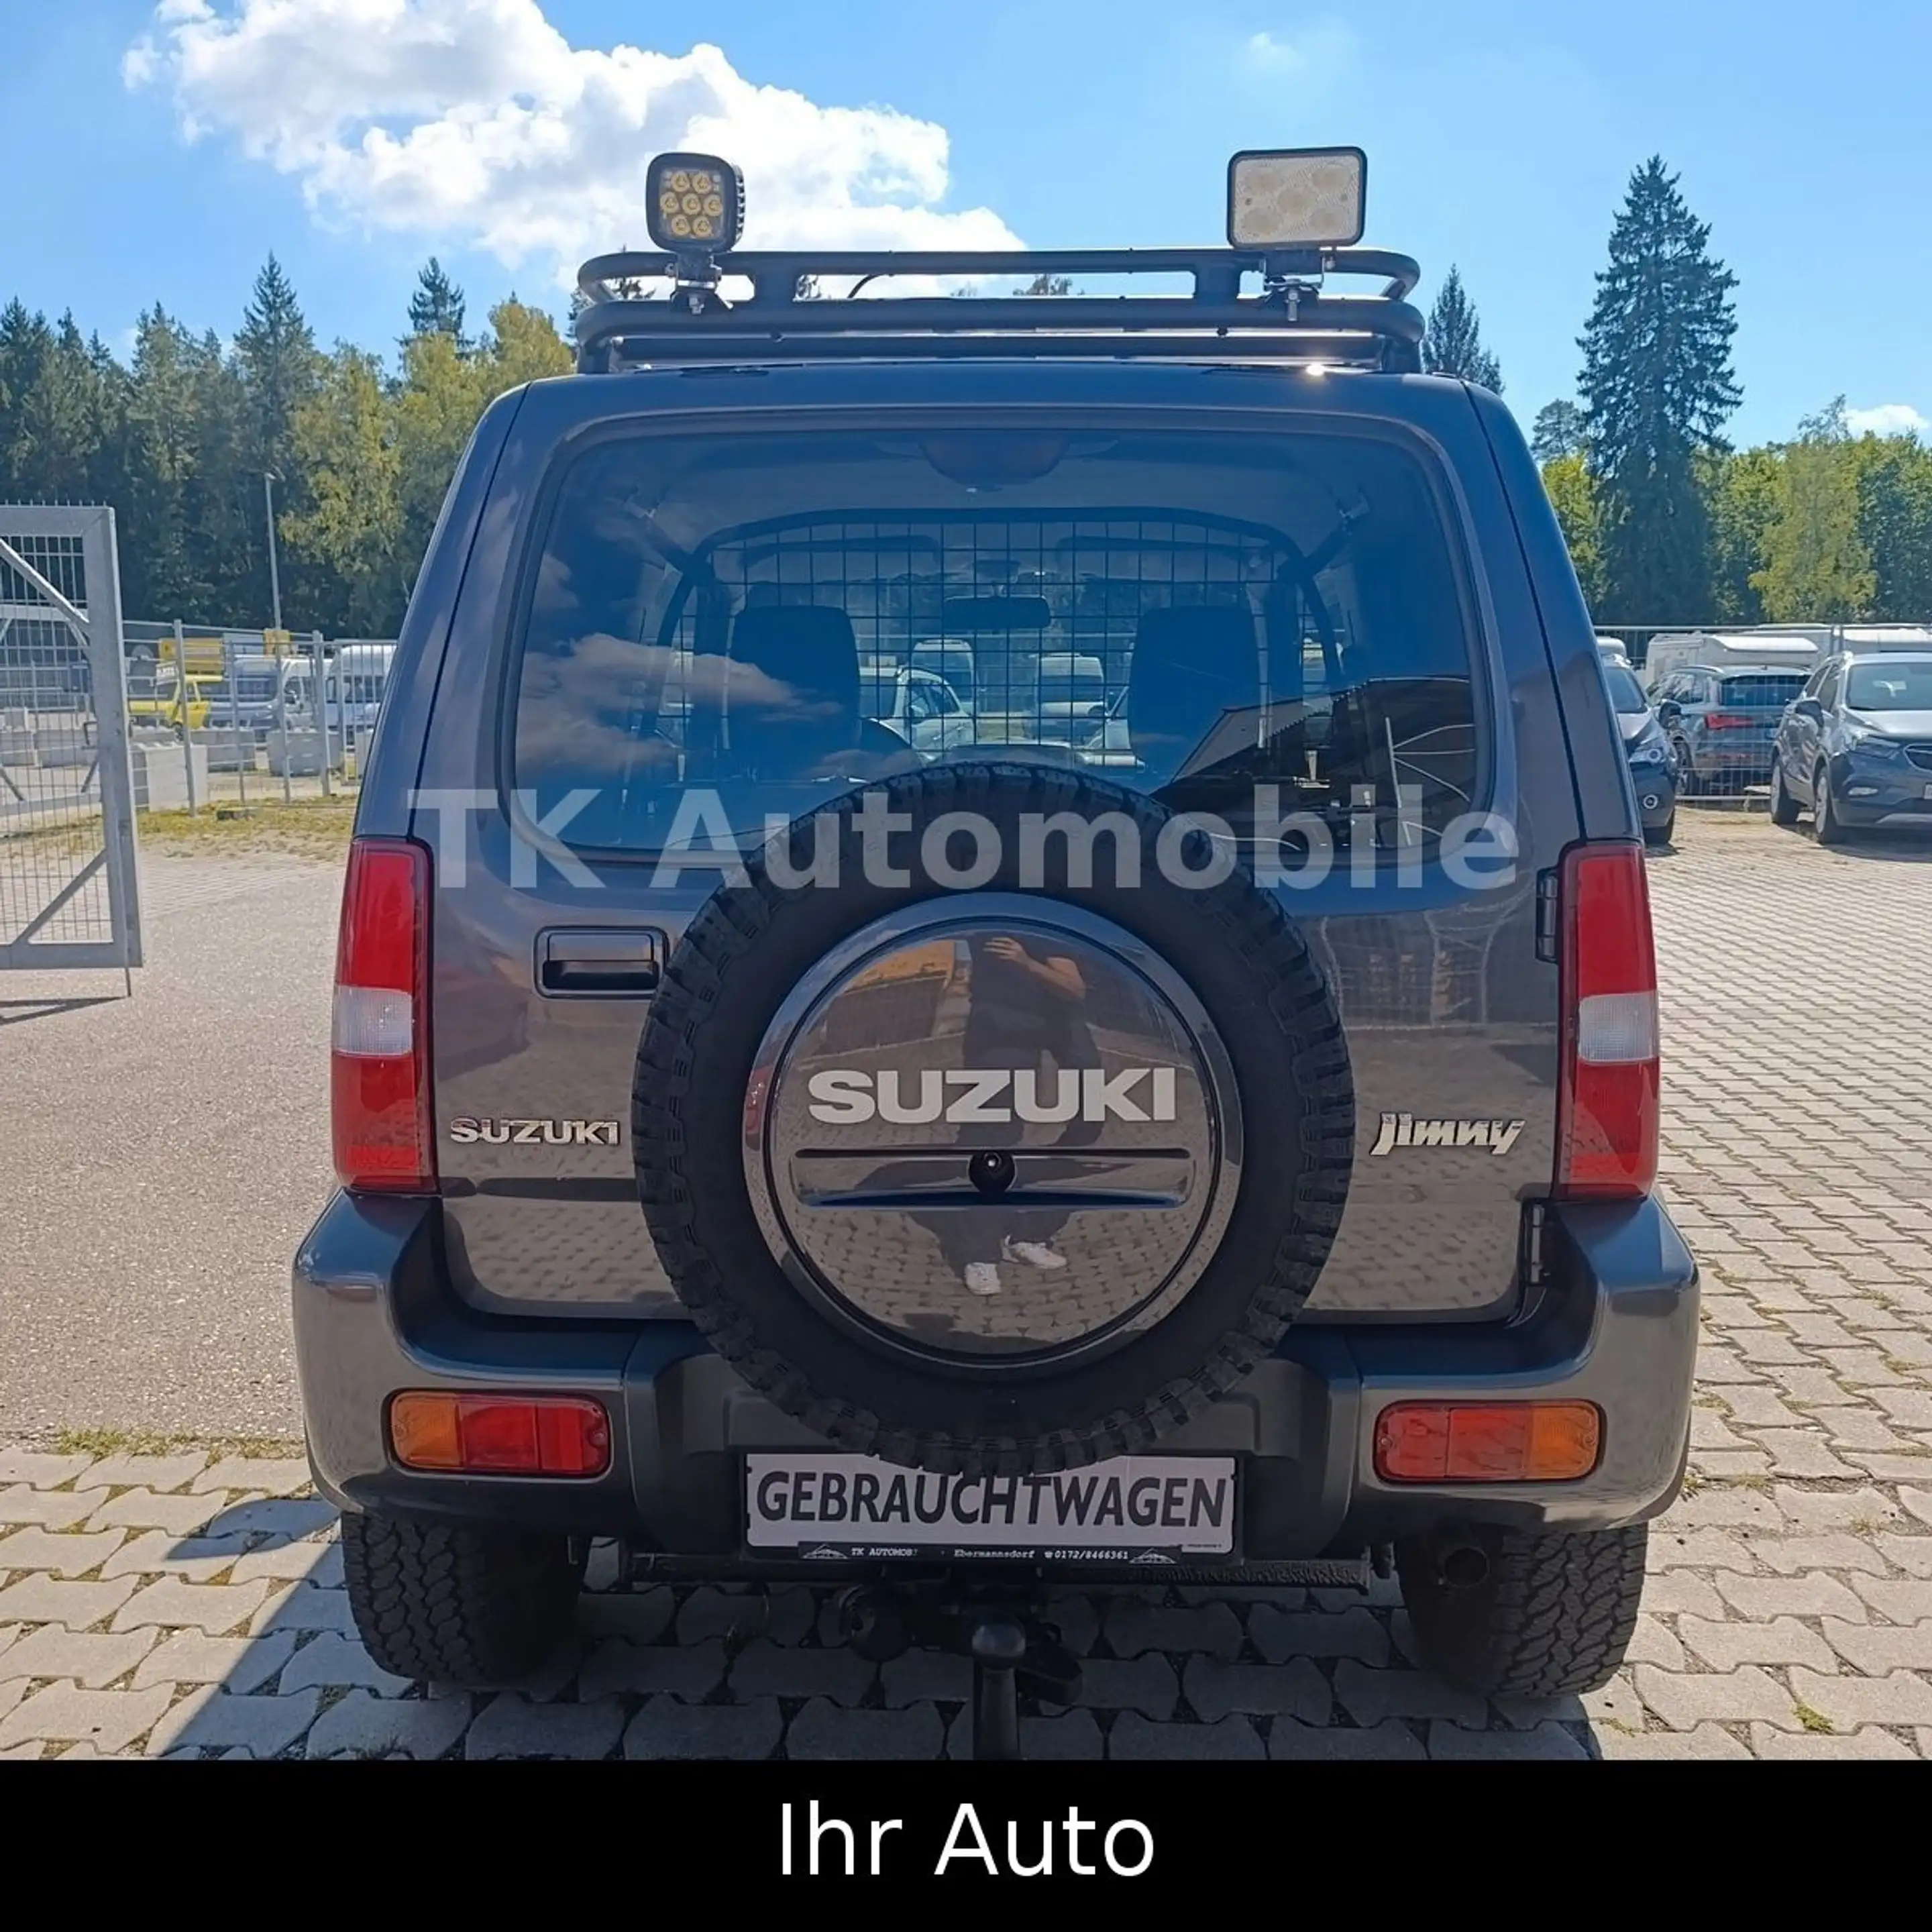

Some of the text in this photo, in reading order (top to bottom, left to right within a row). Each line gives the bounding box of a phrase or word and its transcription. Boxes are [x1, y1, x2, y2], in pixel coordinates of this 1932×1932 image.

[807, 1067, 1175, 1124] SUZUKI
[450, 1116, 619, 1144] SUZUKI
[756, 1470, 1228, 1527] GEBRAUCHTWAGEN
[851, 1548, 864, 1556] TK
